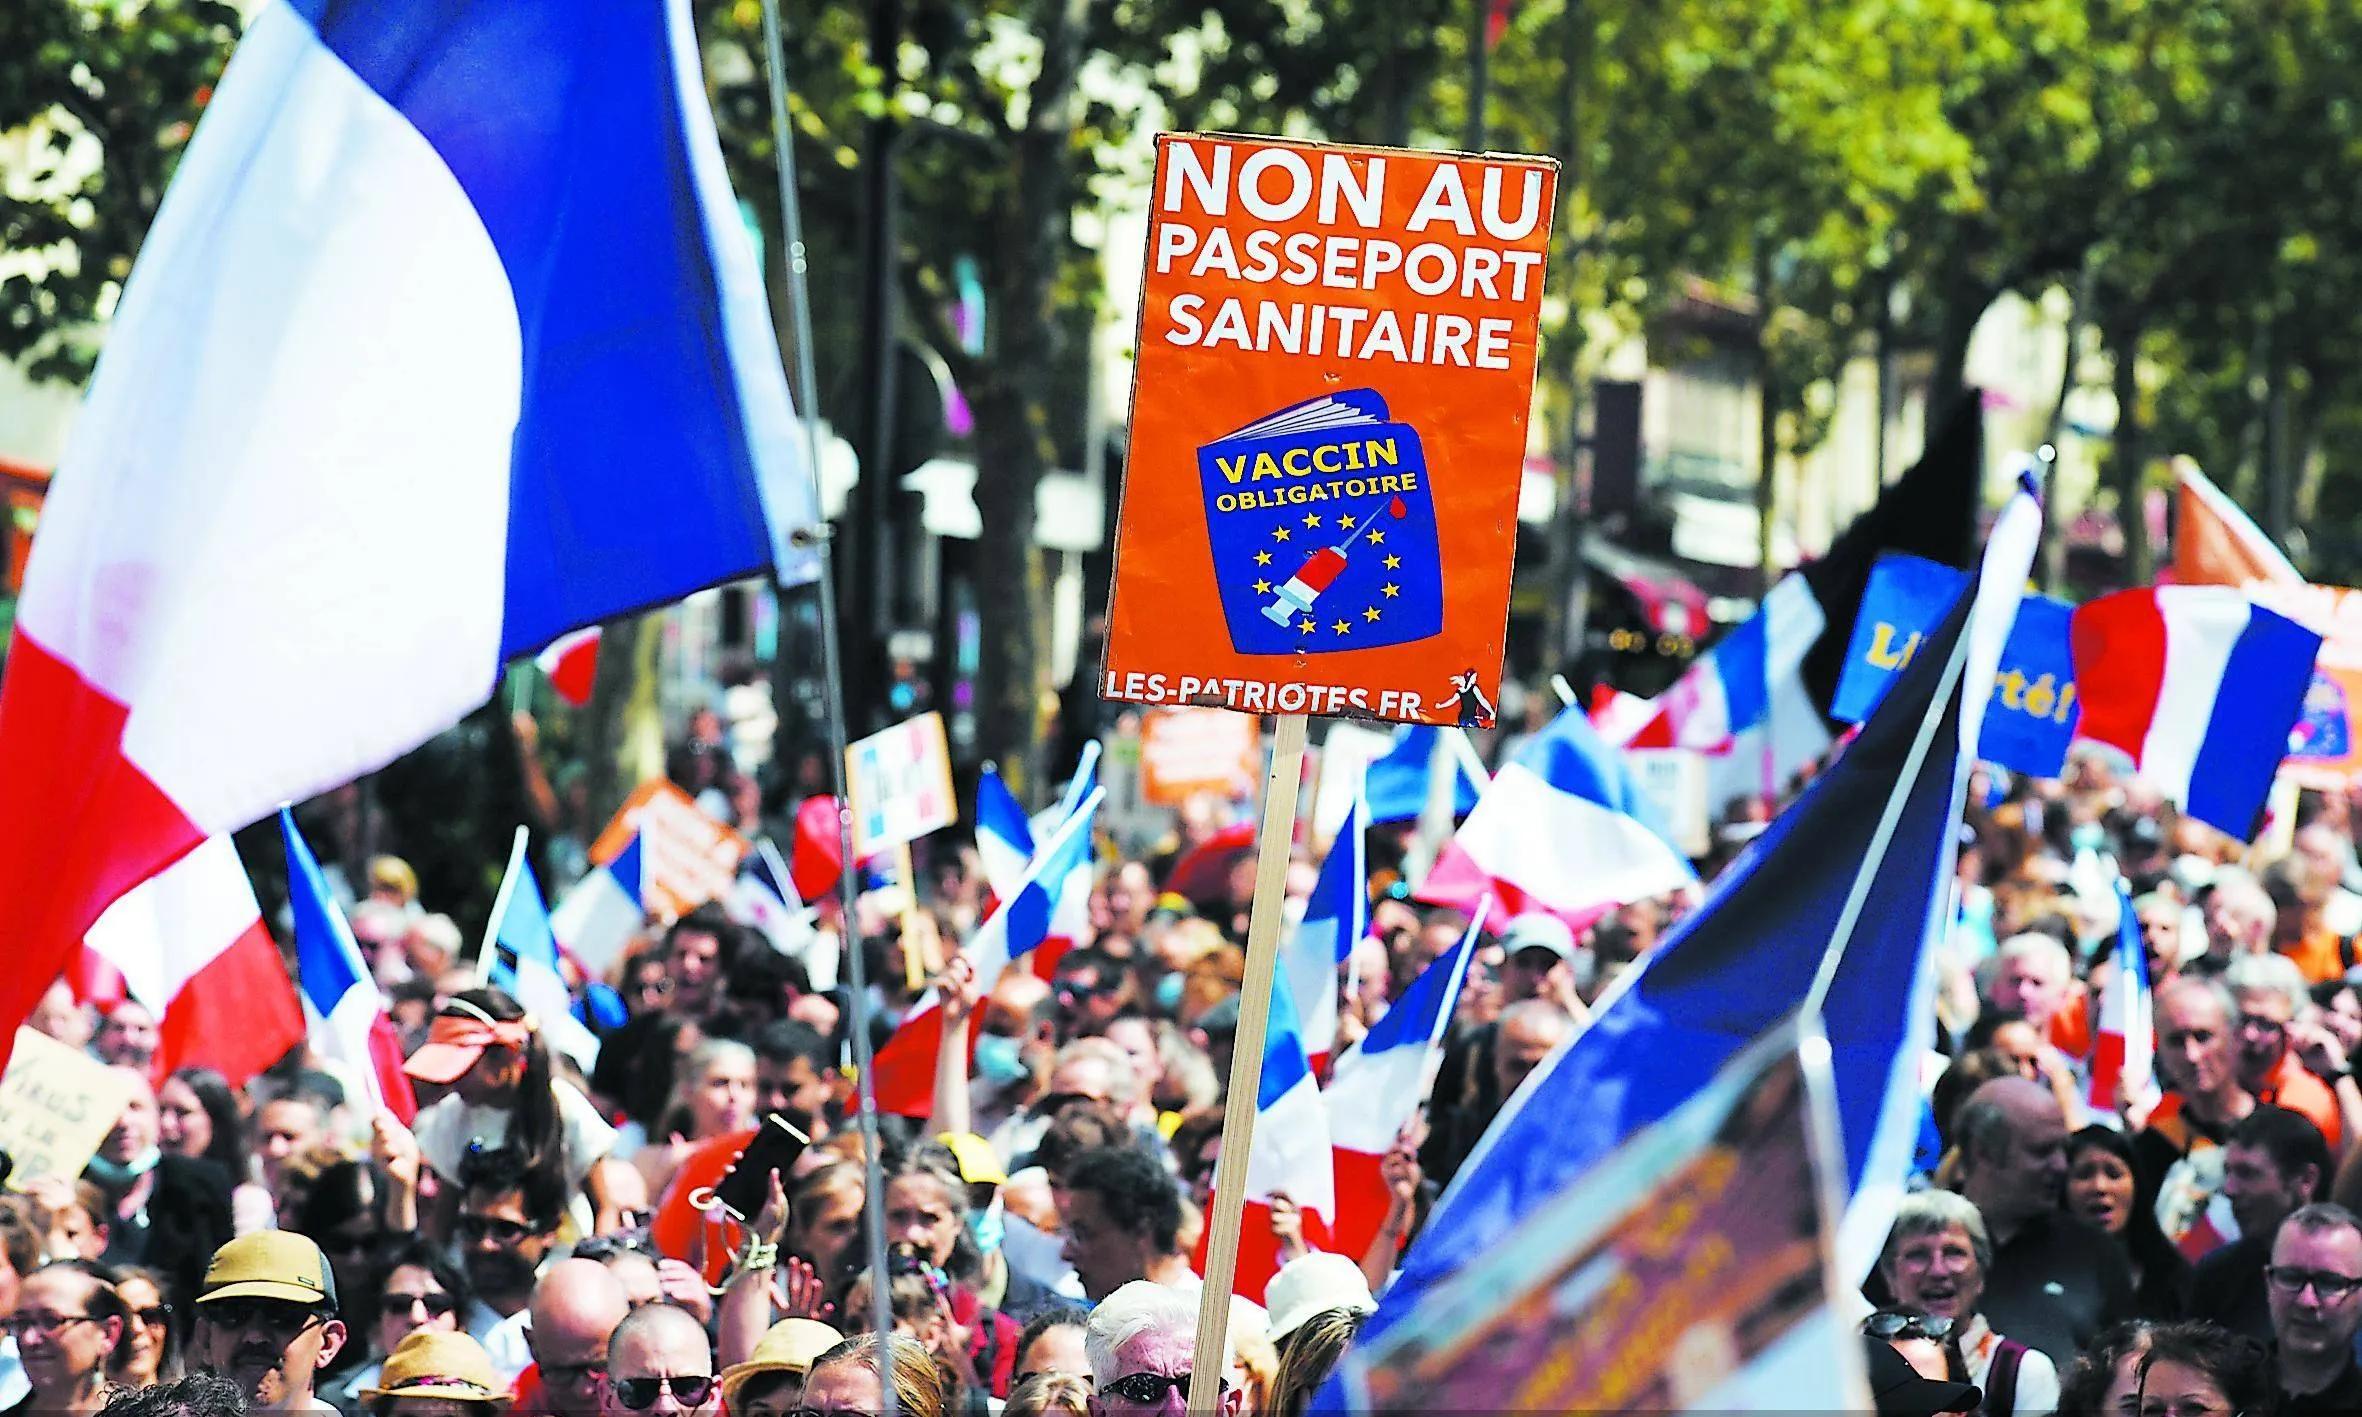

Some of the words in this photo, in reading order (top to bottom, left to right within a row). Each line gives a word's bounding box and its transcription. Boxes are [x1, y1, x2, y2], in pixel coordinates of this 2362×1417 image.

[1163, 141, 1386, 229] NON
[1405, 163, 1543, 241] AU
[1156, 222, 1542, 302] PASSEPORT
[1164, 293, 1513, 370] SANITAIRE
[1215, 438, 1398, 484] VACCIN
[1216, 473, 1418, 512] OBLIGATOIRE
[1105, 670, 1422, 720] LES-PATRIOTES.FR
